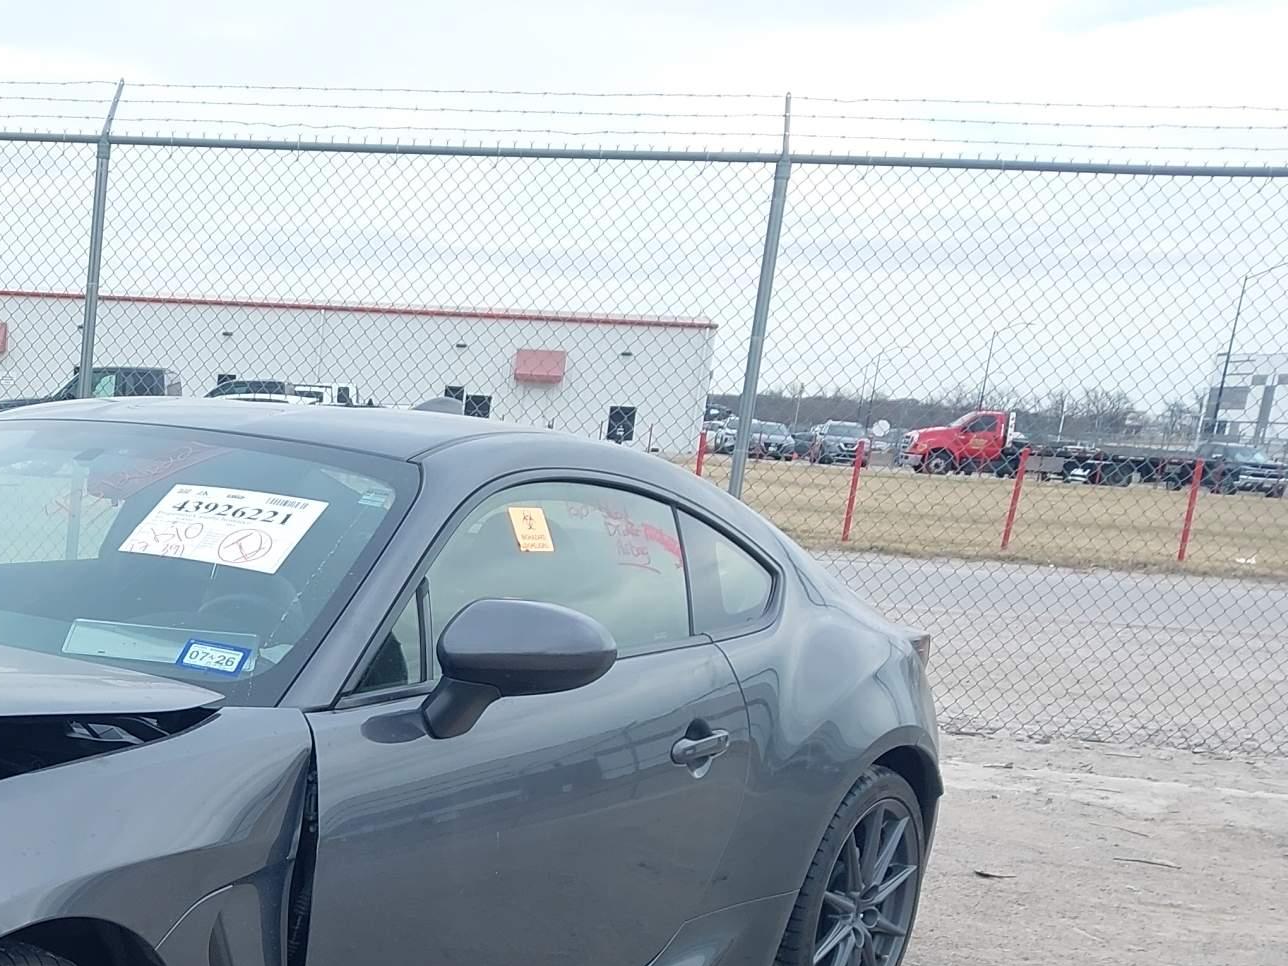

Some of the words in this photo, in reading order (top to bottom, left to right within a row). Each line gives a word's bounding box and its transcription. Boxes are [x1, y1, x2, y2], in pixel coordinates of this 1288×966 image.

[172, 500, 292, 525] 43926221
[188, 650, 210, 661] 07
[214, 654, 237, 667] 26
